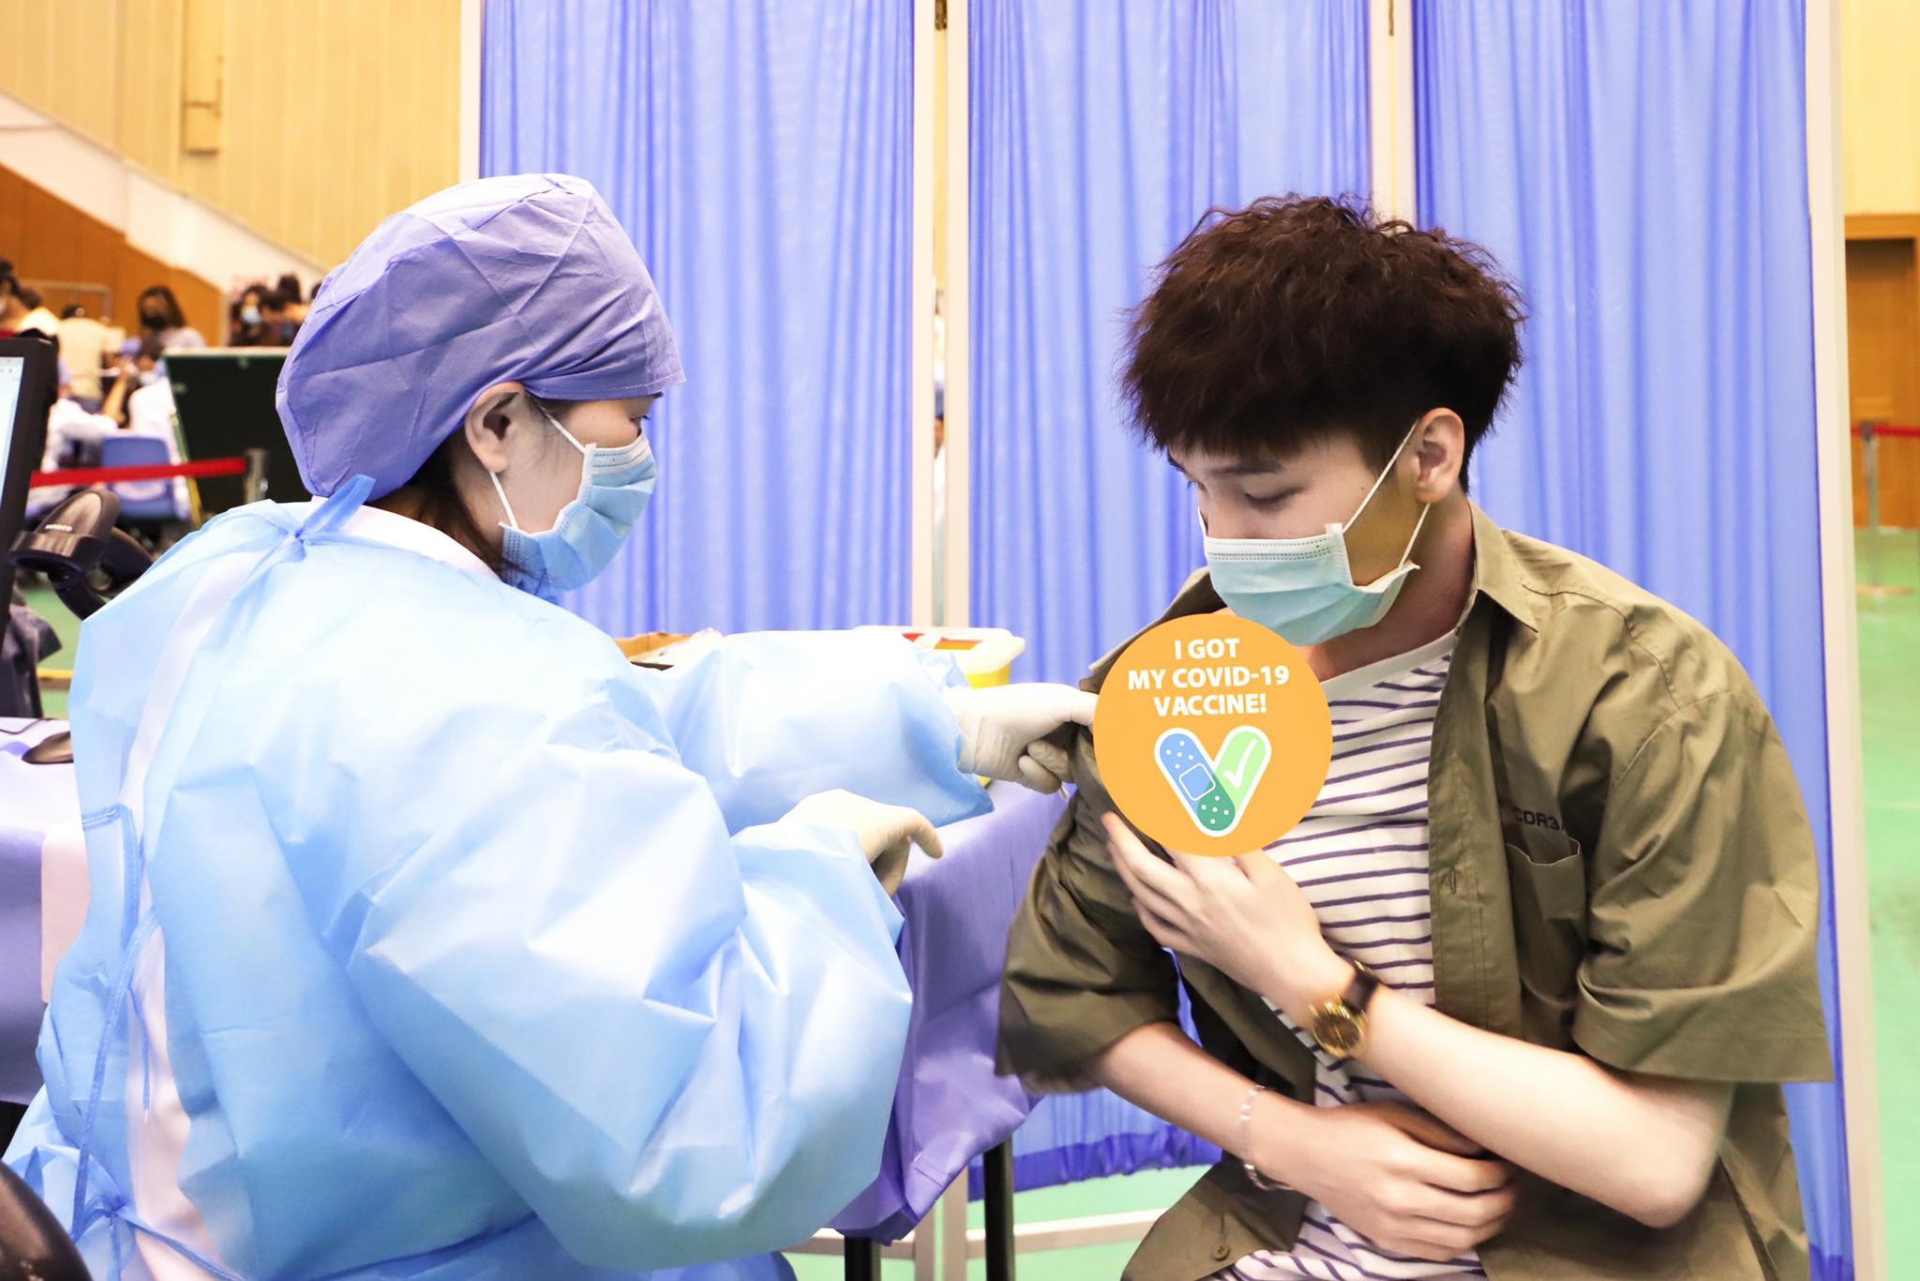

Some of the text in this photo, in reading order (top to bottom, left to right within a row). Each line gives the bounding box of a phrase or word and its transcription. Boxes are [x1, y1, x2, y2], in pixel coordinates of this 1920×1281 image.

[1174, 637, 1241, 660] I GOT
[1128, 665, 1290, 690] MY COVID-19
[1153, 693, 1267, 717] VACCINE!
